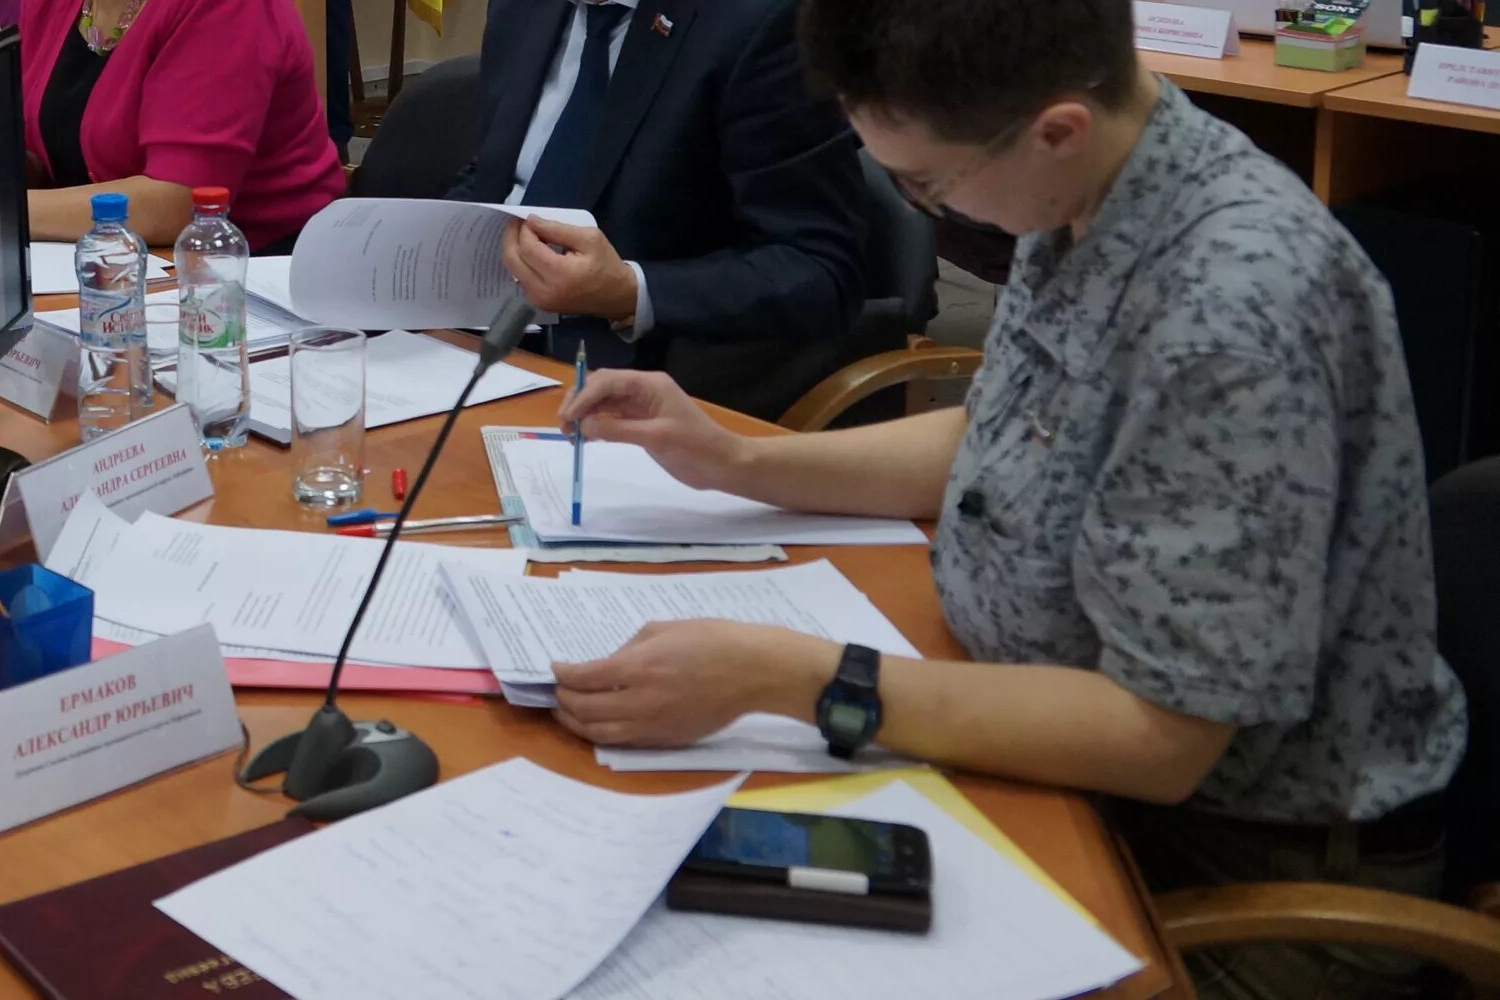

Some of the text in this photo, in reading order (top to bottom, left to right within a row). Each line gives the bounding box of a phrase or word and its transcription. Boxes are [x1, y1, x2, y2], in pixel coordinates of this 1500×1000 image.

[1315, 3, 1360, 14] SONY
[92, 443, 146, 475] АНДРЕЕВА
[129, 448, 187, 485] СЕРГЕЕВНА
[59, 674, 137, 713] ЕРМАКОВ
[13, 712, 112, 759] АЛЕКСАНДР
[115, 683, 195, 724] ЮРЬЕВИЧ
